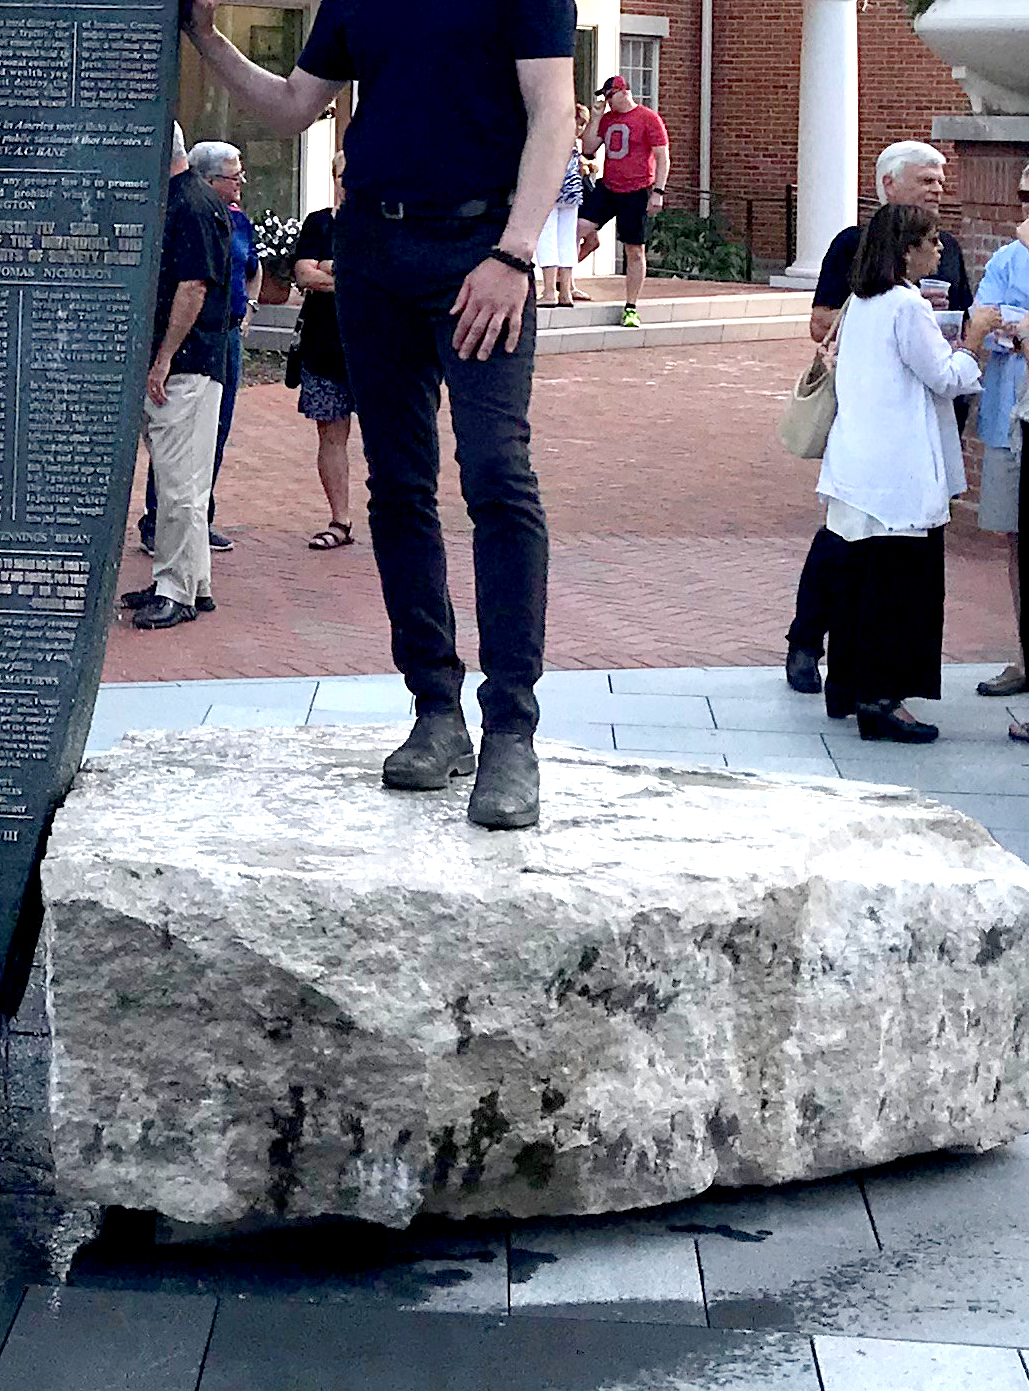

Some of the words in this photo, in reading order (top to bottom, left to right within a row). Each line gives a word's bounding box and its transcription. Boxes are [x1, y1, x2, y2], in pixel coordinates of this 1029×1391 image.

[3, 120, 13, 129] in
[605, 122, 631, 160] O
[3, 177, 20, 187] any
[94, 178, 104, 188] to
[108, 179, 149, 190] promote
[10, 235, 34, 249] THE
[54, 533, 91, 545] BRYAN
[5, 675, 60, 686] MATTHEWS
